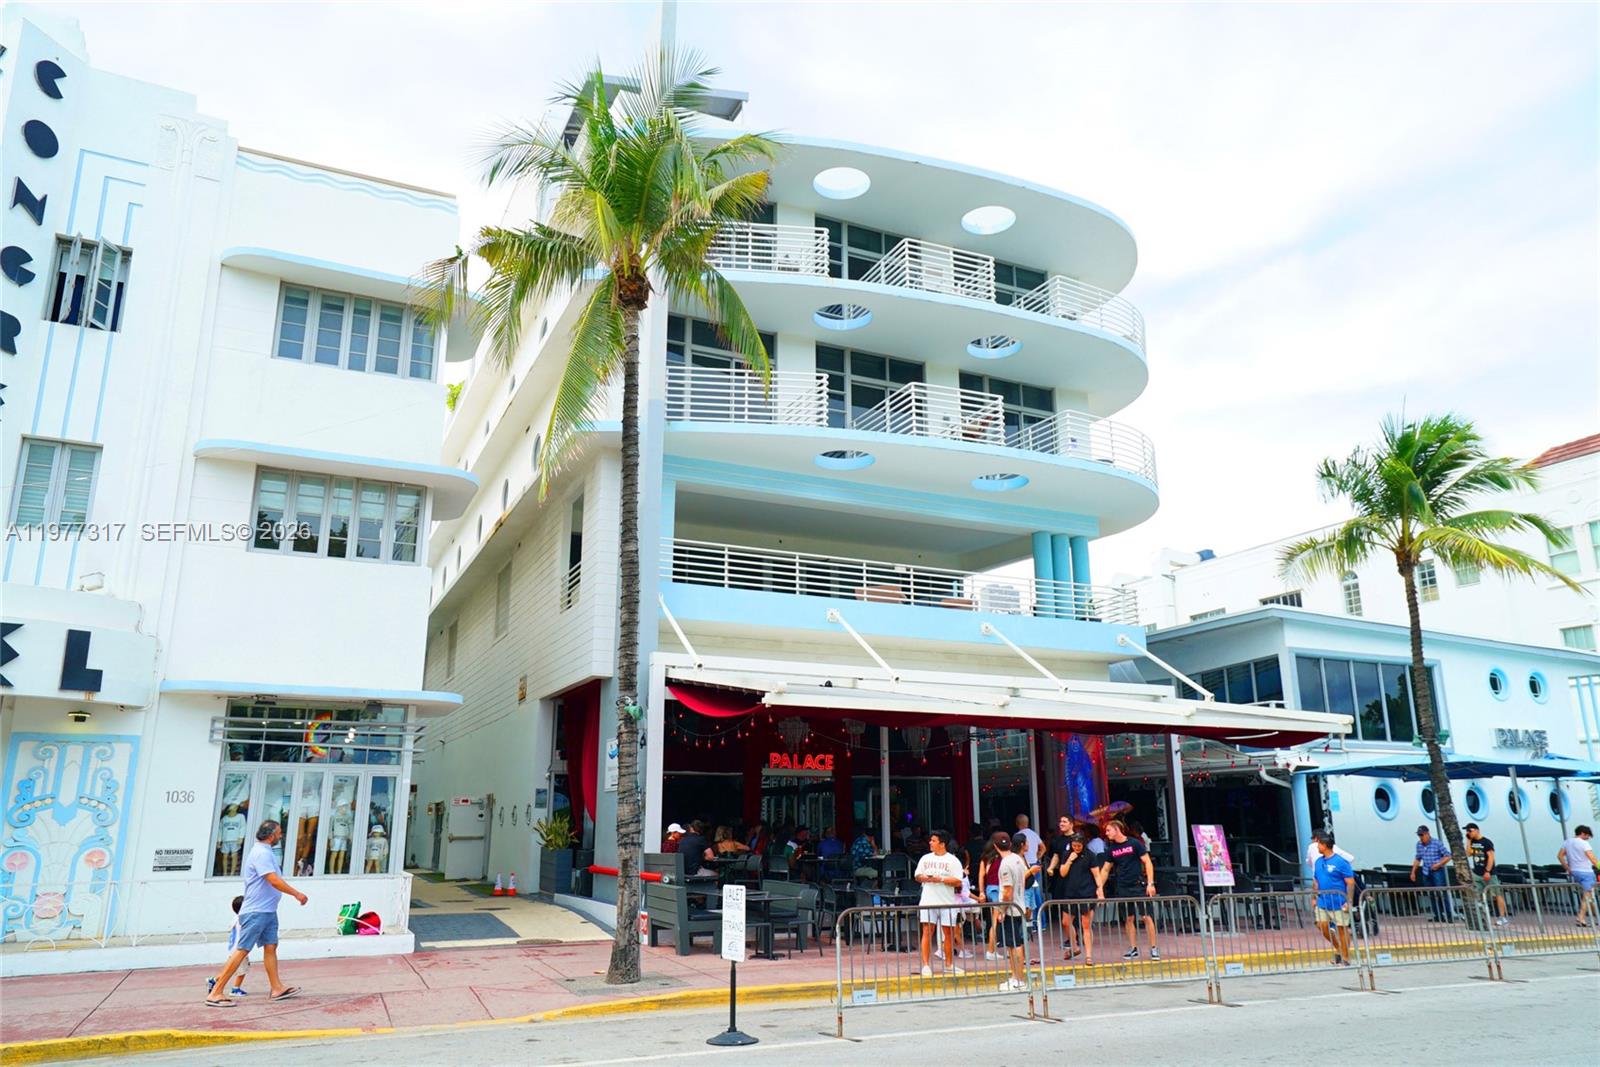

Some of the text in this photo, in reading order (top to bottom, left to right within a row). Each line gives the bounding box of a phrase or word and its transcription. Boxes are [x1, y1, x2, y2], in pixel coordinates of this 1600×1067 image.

[0, 60, 67, 420] CONGR
[1494, 728, 1548, 749] PALACE
[769, 752, 834, 770] PALACE
[165, 790, 195, 804] 1036
[725, 887, 744, 902] VALET
